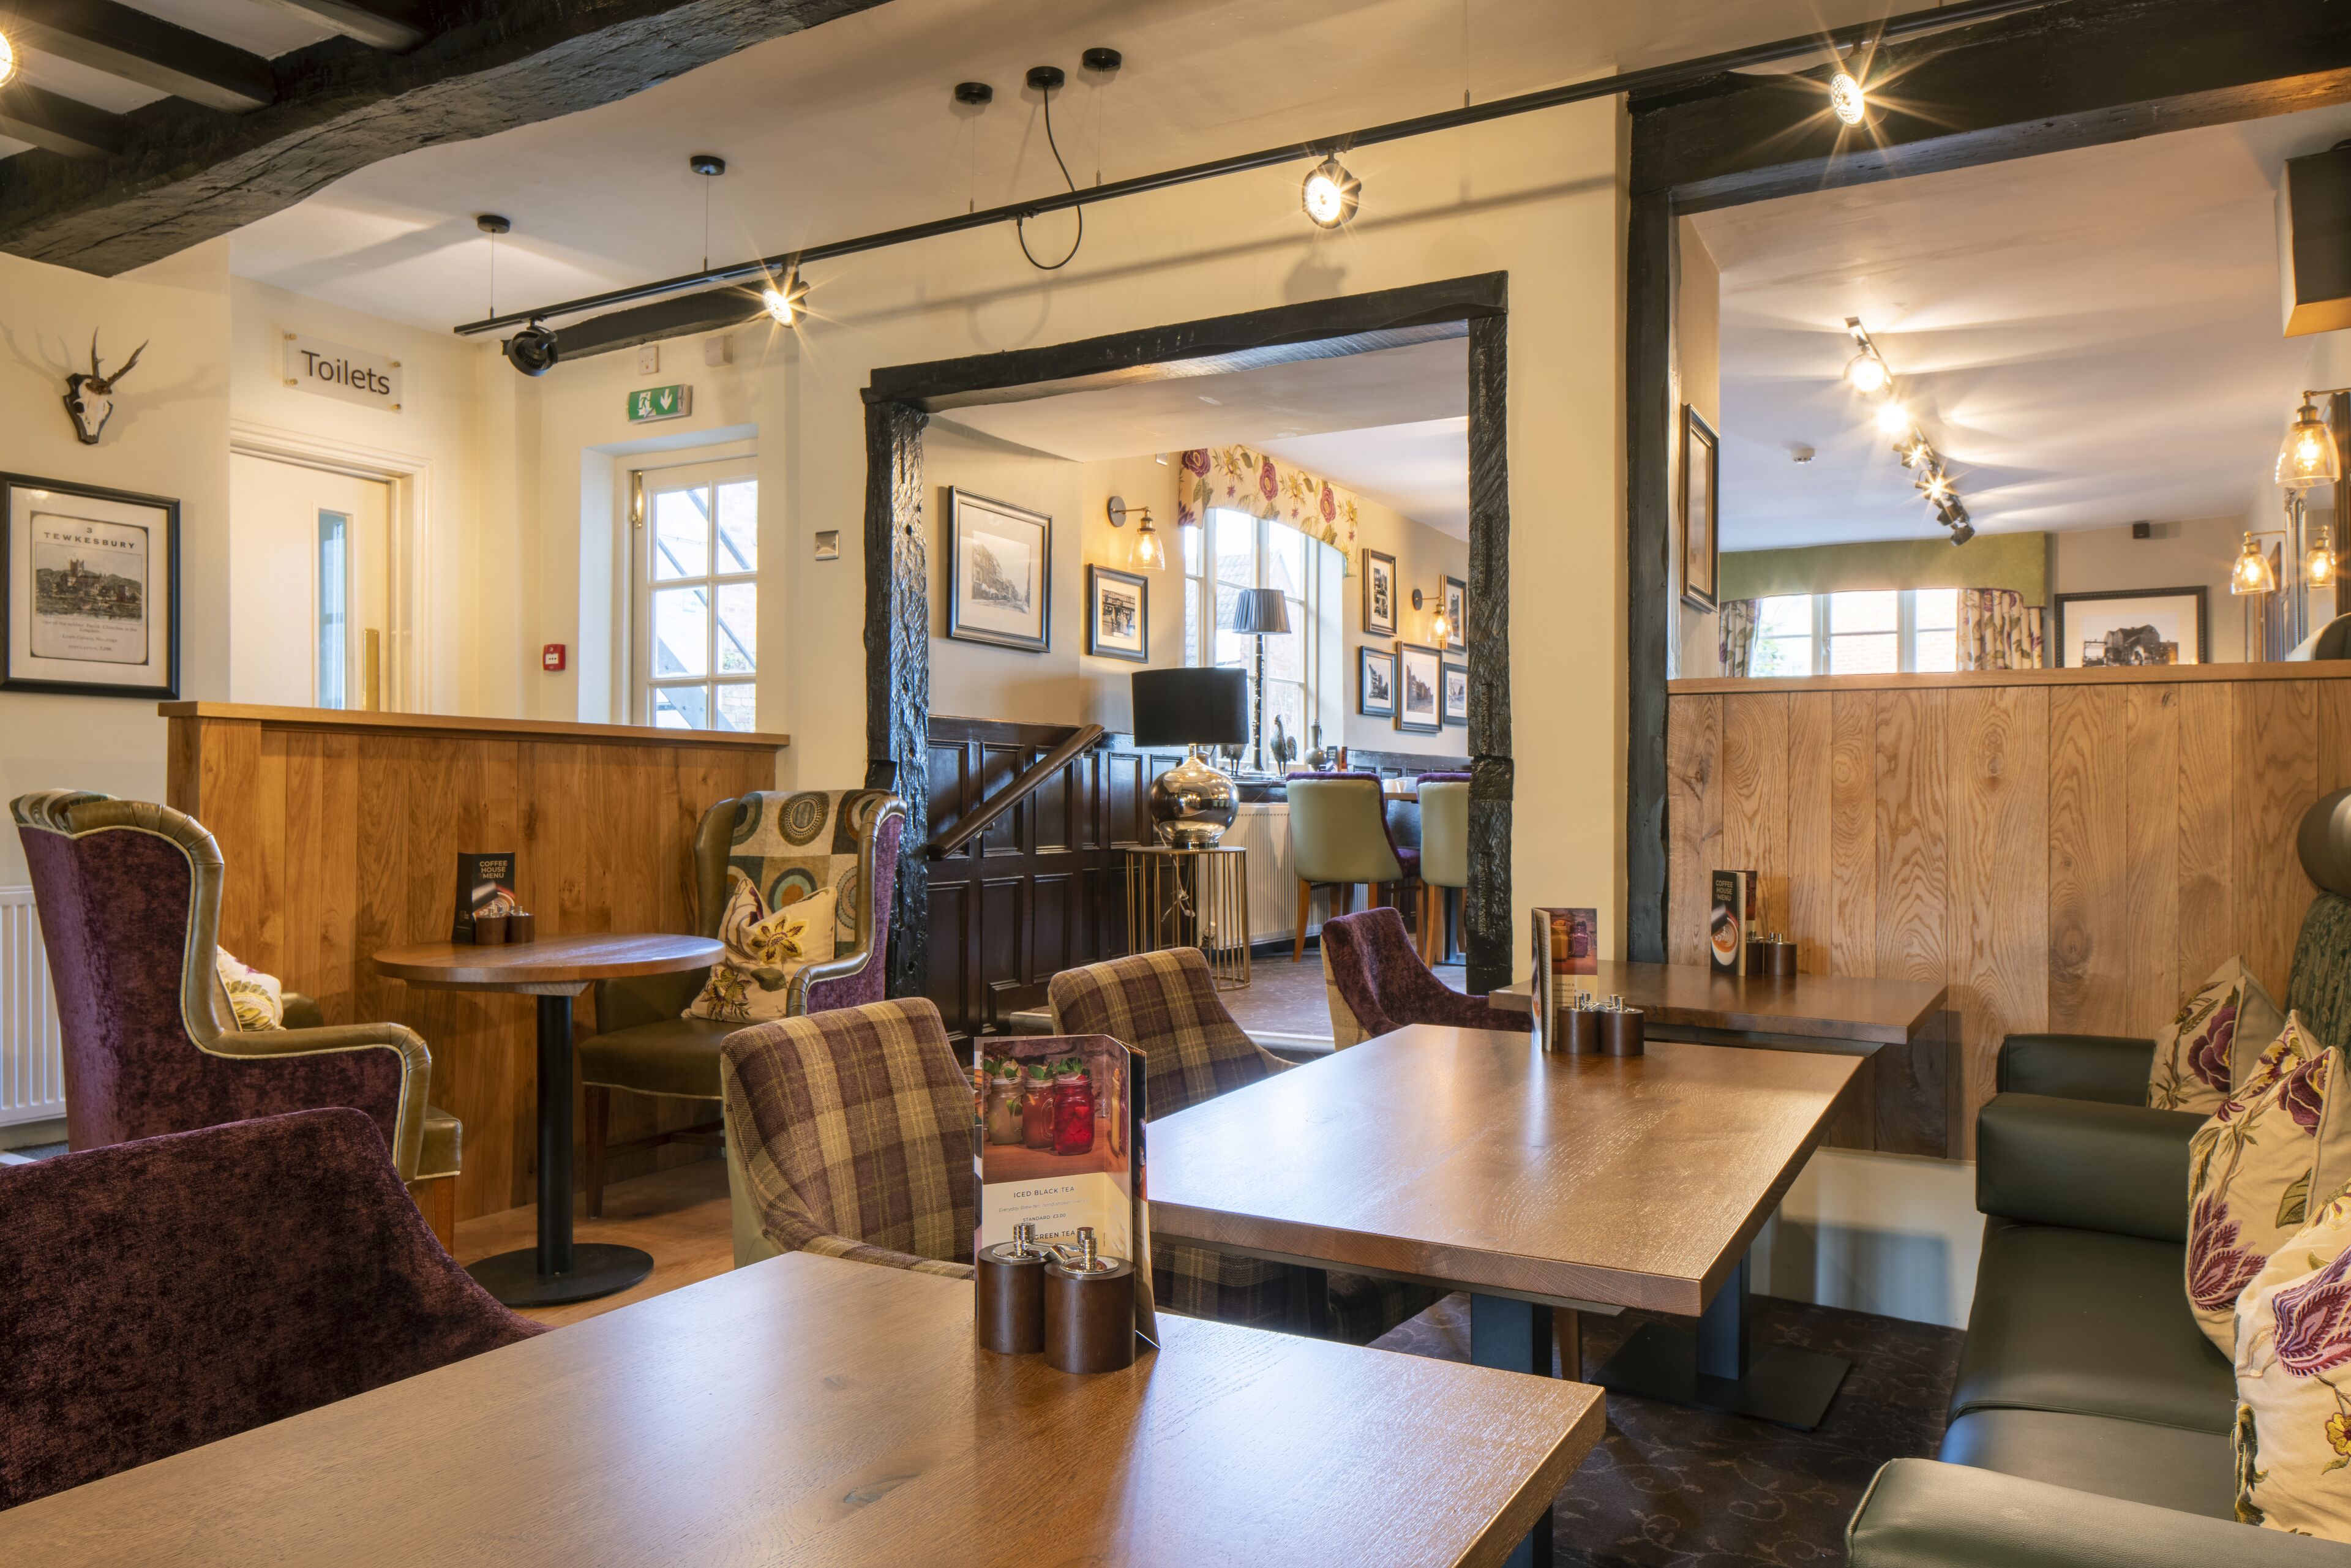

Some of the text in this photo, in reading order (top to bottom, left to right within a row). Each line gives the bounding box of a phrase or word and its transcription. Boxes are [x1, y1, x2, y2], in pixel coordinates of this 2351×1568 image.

[301, 350, 391, 395] Toilets
[43, 531, 135, 549] TEWKESBURY
[1035, 1231, 1059, 1240] GREEN
